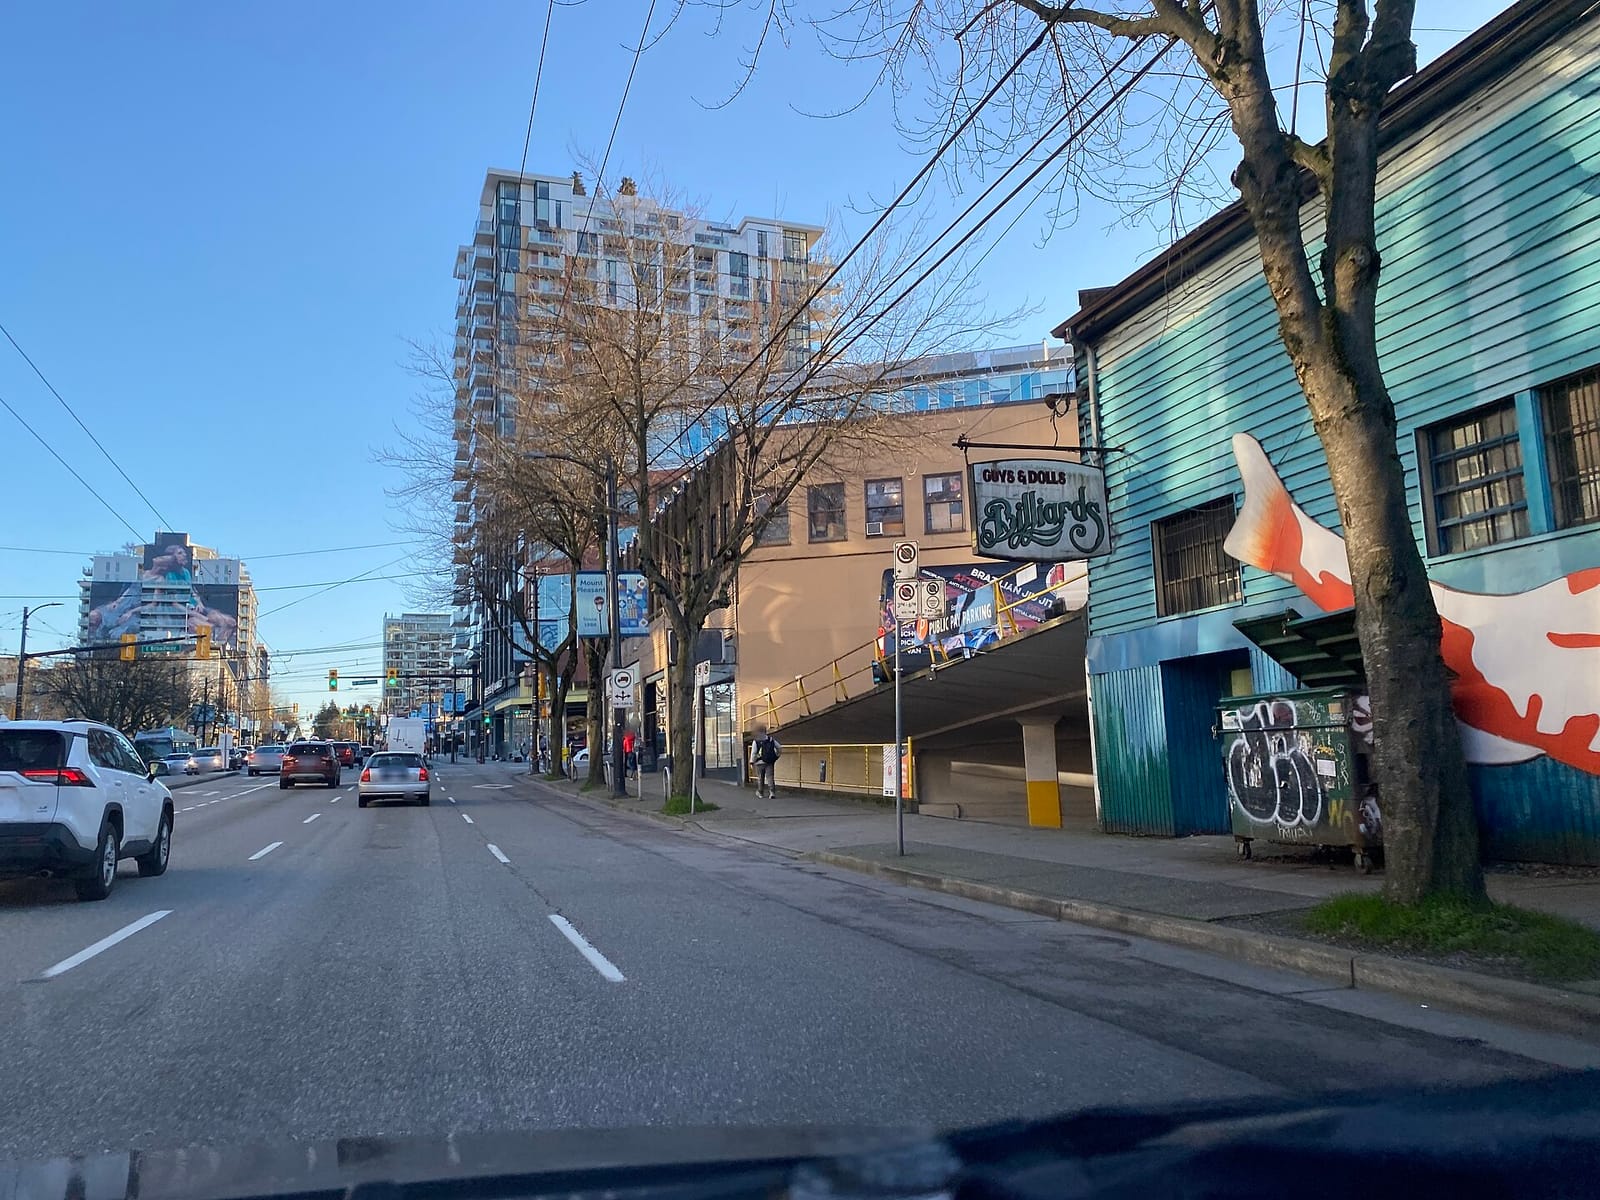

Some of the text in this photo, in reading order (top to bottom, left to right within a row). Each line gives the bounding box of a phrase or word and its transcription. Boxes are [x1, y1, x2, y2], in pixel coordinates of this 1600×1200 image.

[983, 469, 1066, 485] GUYS & DOLLS
[980, 486, 1105, 553] Billiards
[970, 568, 1022, 595] BRAZLIAN
[928, 618, 949, 635] PUBLIC
[950, 614, 961, 629] PAY
[962, 603, 992, 624] PARKING
